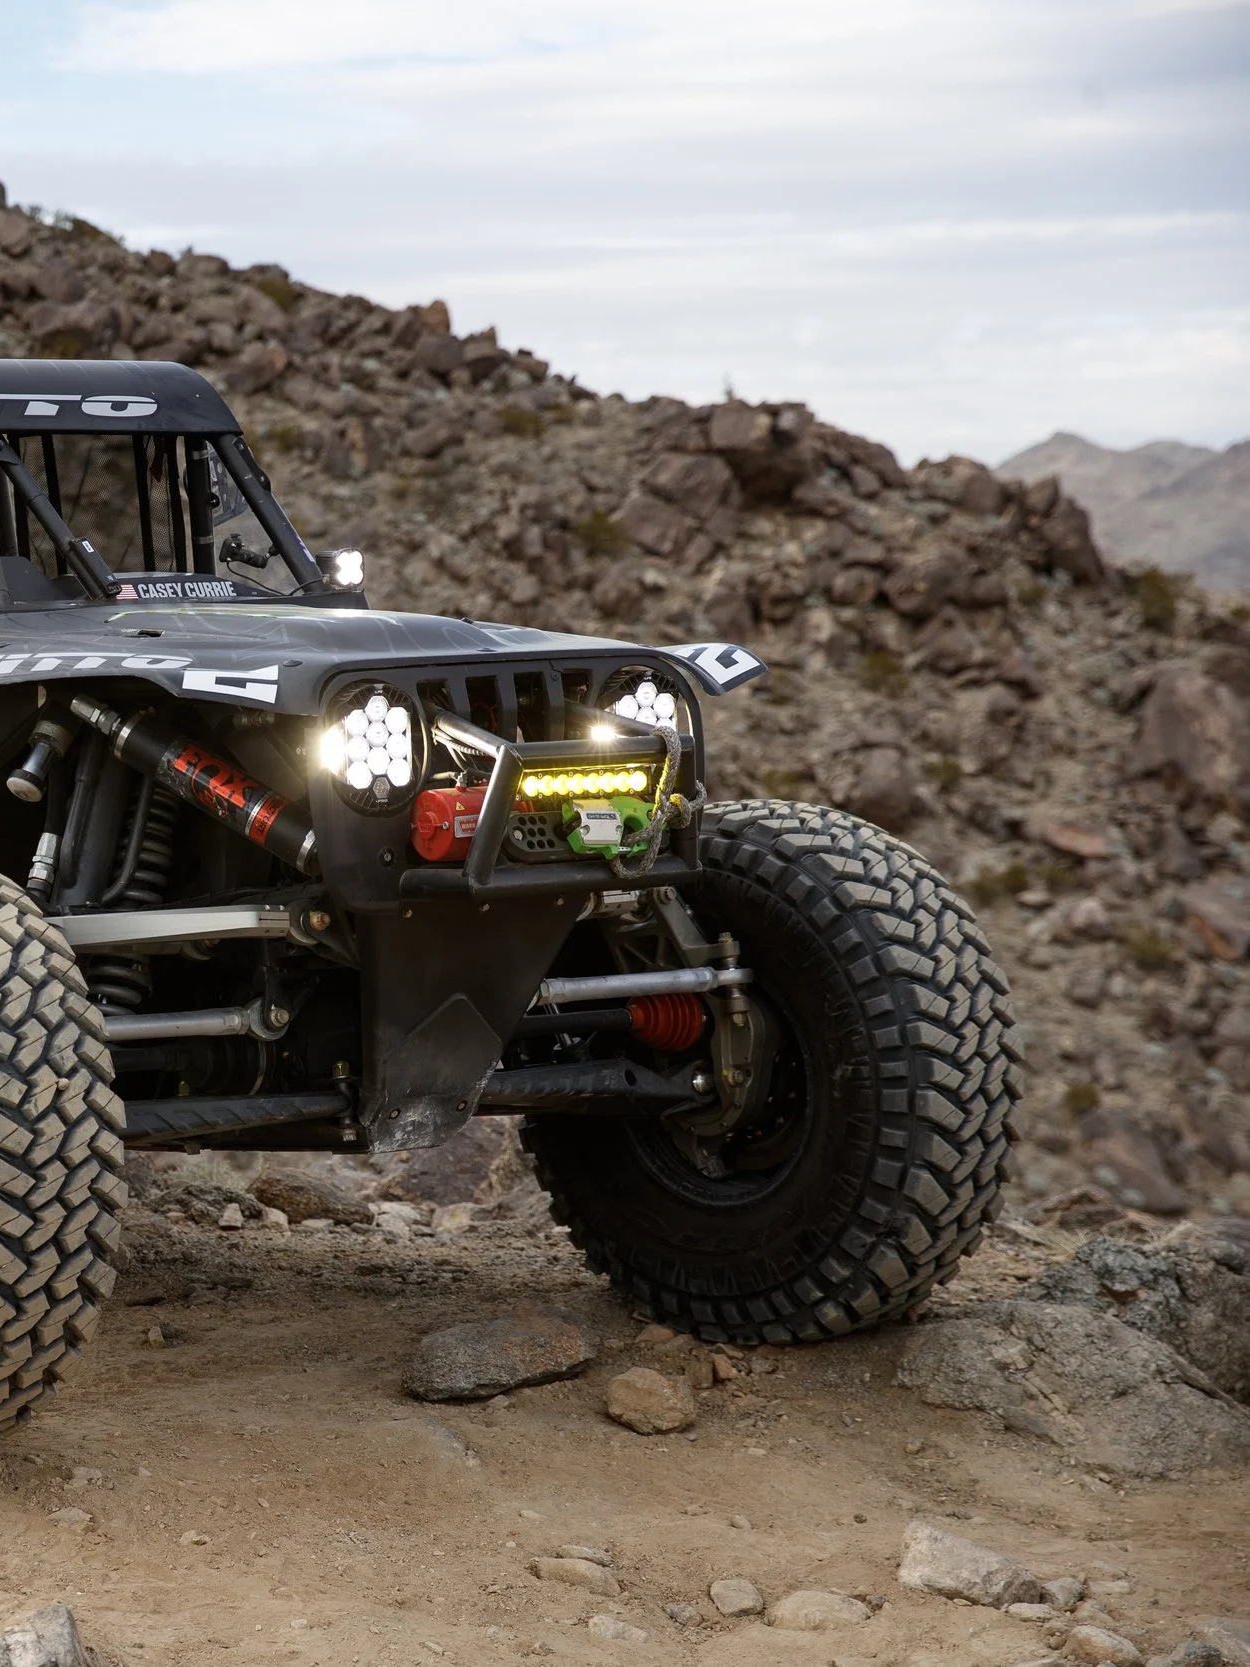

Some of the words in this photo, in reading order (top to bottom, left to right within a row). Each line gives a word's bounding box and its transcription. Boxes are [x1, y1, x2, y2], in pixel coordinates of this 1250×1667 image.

[137, 583, 183, 599] CASEY
[184, 581, 237, 597] CURRIE
[174, 744, 259, 809] FOX
